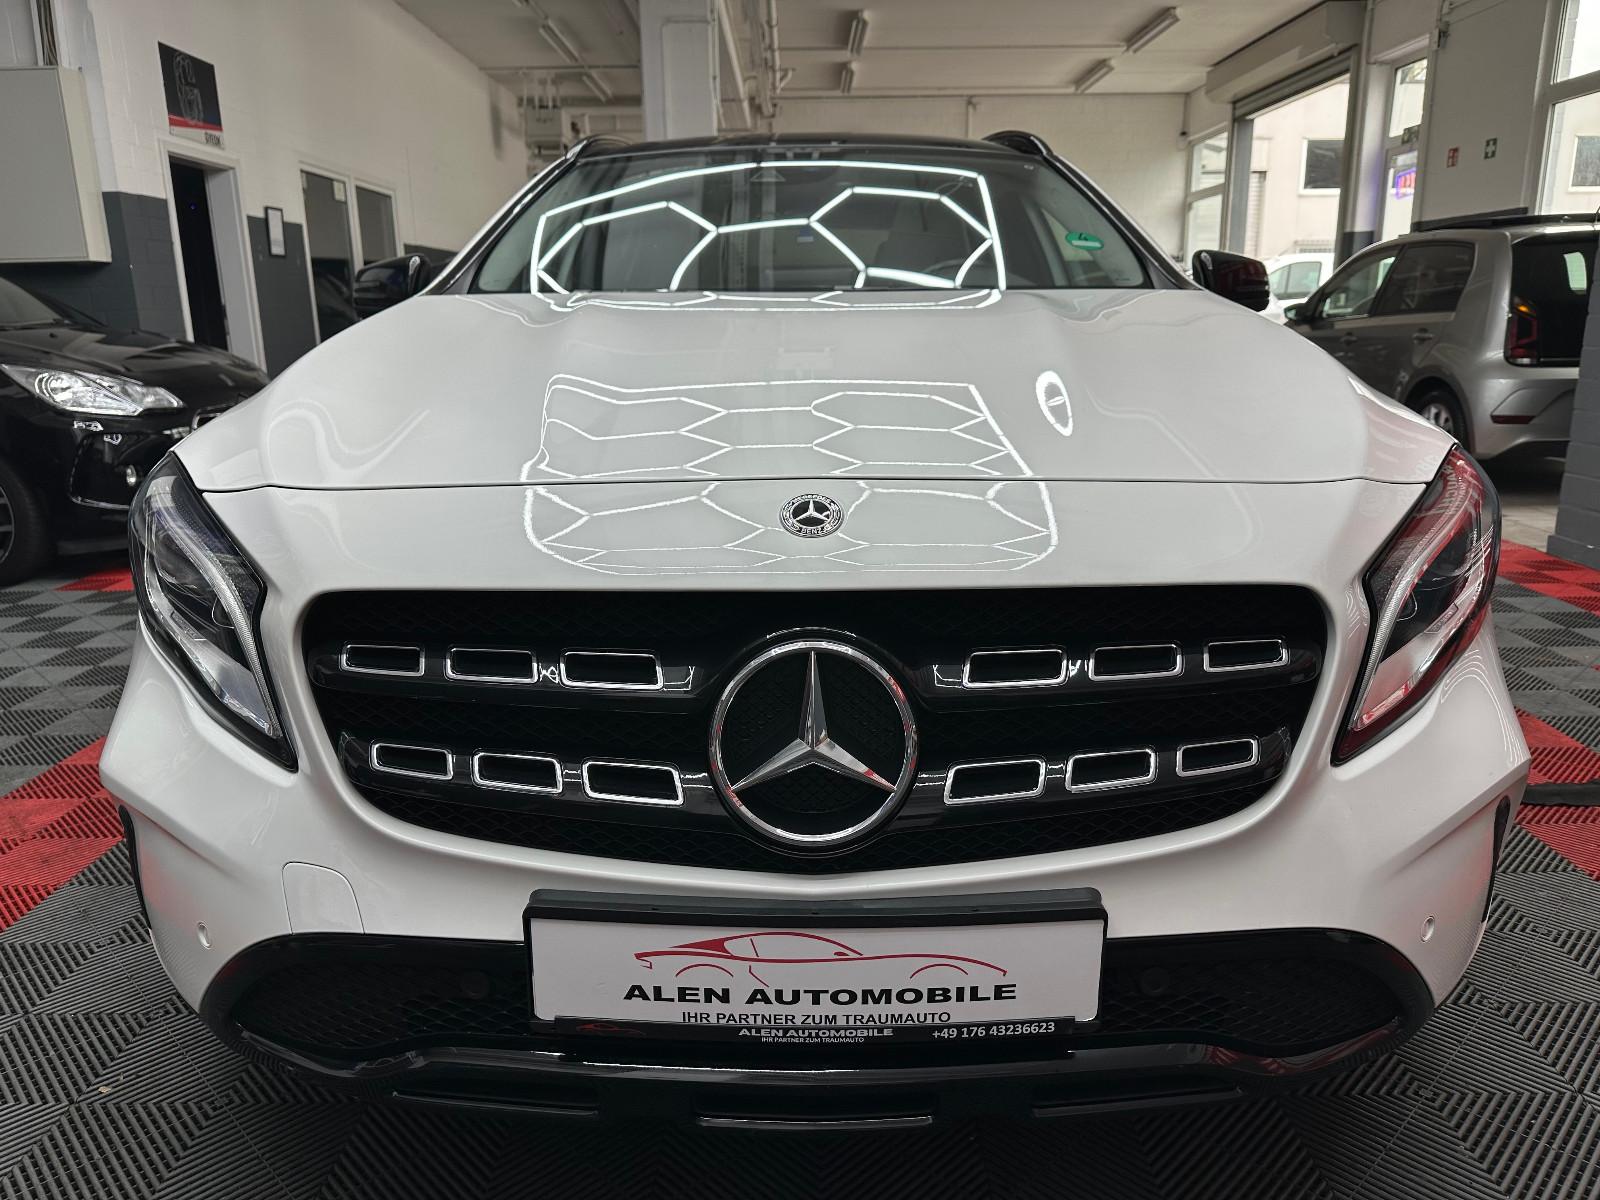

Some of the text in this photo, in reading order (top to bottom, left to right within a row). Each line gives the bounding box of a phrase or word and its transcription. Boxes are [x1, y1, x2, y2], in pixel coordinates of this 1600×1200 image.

[623, 983, 1016, 1005] ALEN AUTOMOBILE
[682, 1011, 951, 1025] IHR PARTNER ZUM TRAUMAUTO
[738, 1022, 1055, 1041] ALEN AUTOMOBILE +49 176 43236623
